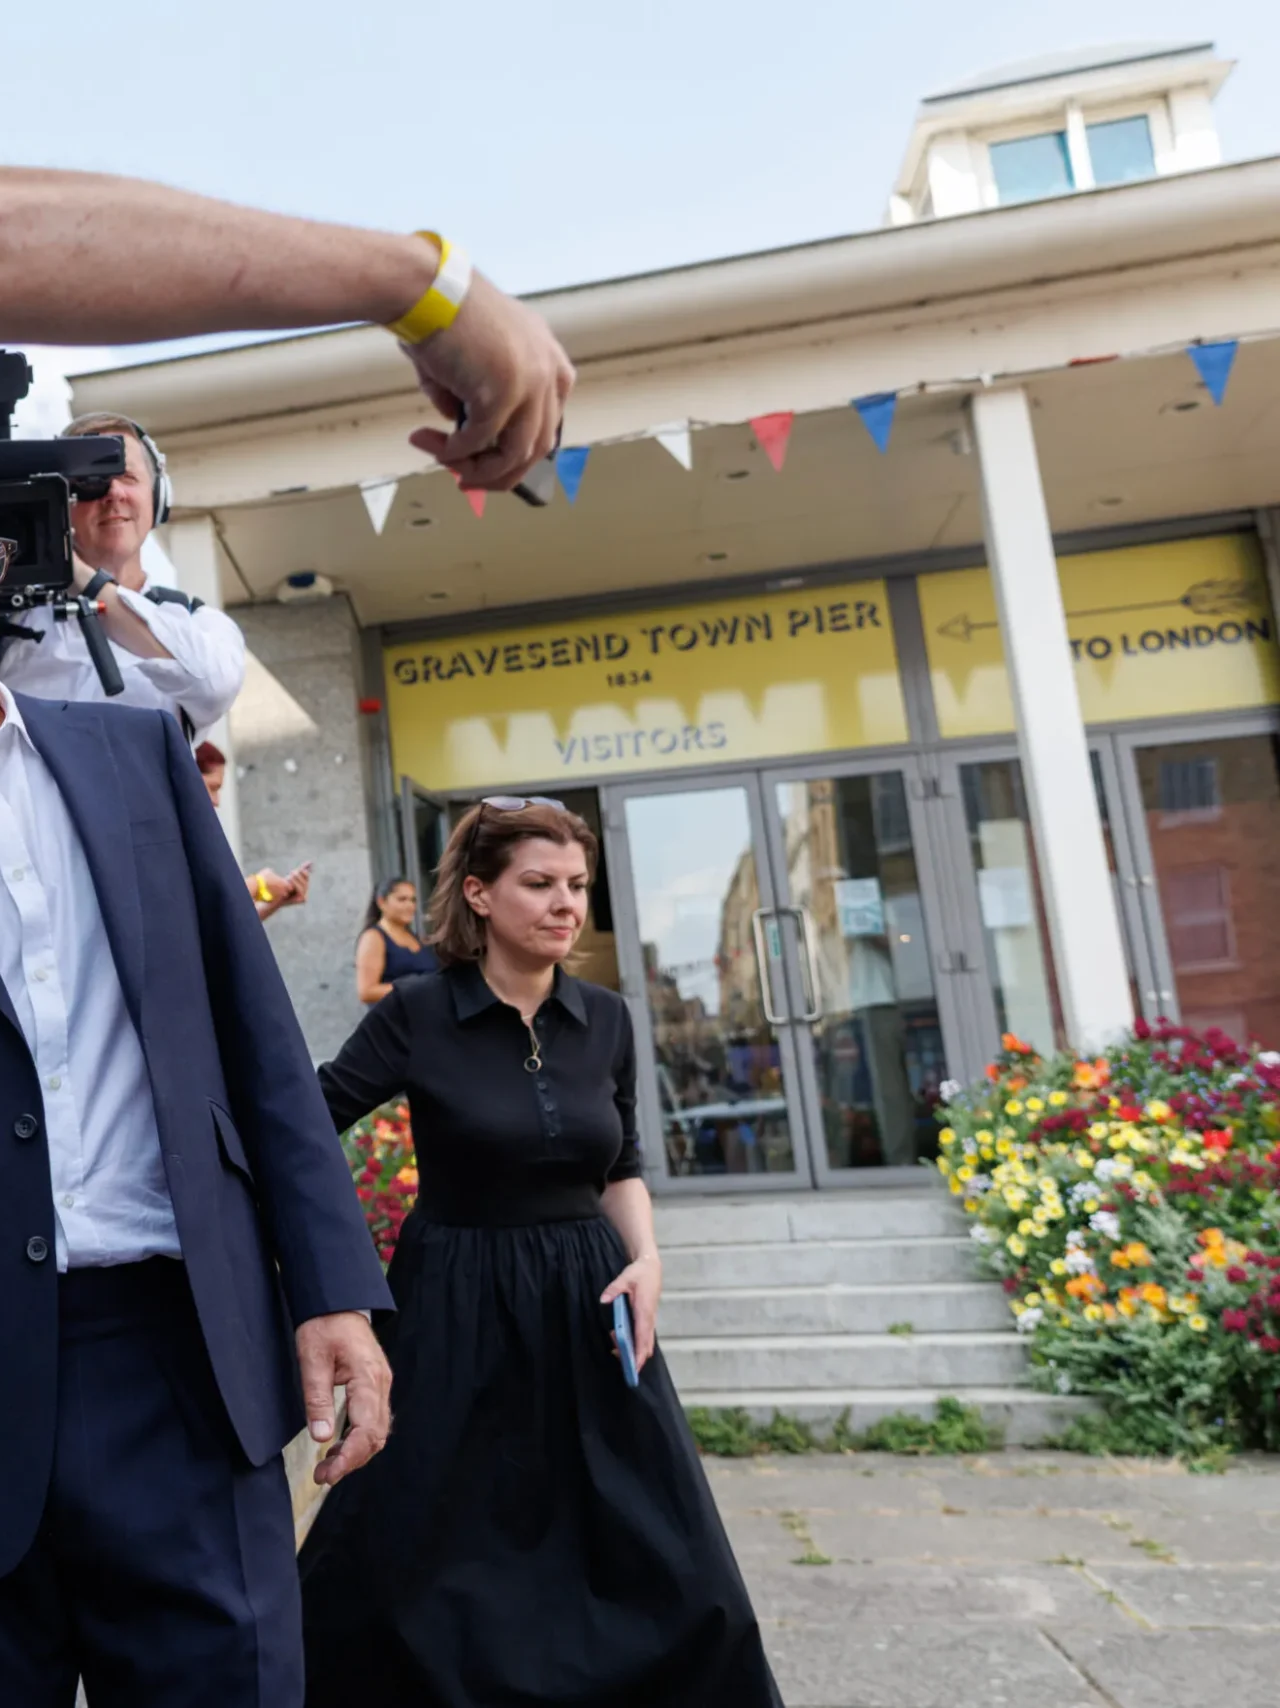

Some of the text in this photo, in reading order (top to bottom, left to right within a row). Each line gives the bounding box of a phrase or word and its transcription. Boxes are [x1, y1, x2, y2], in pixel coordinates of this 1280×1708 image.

[393, 601, 883, 686] GRAVESEND TOWN PIER
[1069, 616, 1271, 661] TO LONDON
[606, 669, 652, 689] 1834
[554, 722, 728, 765] VISITORS
